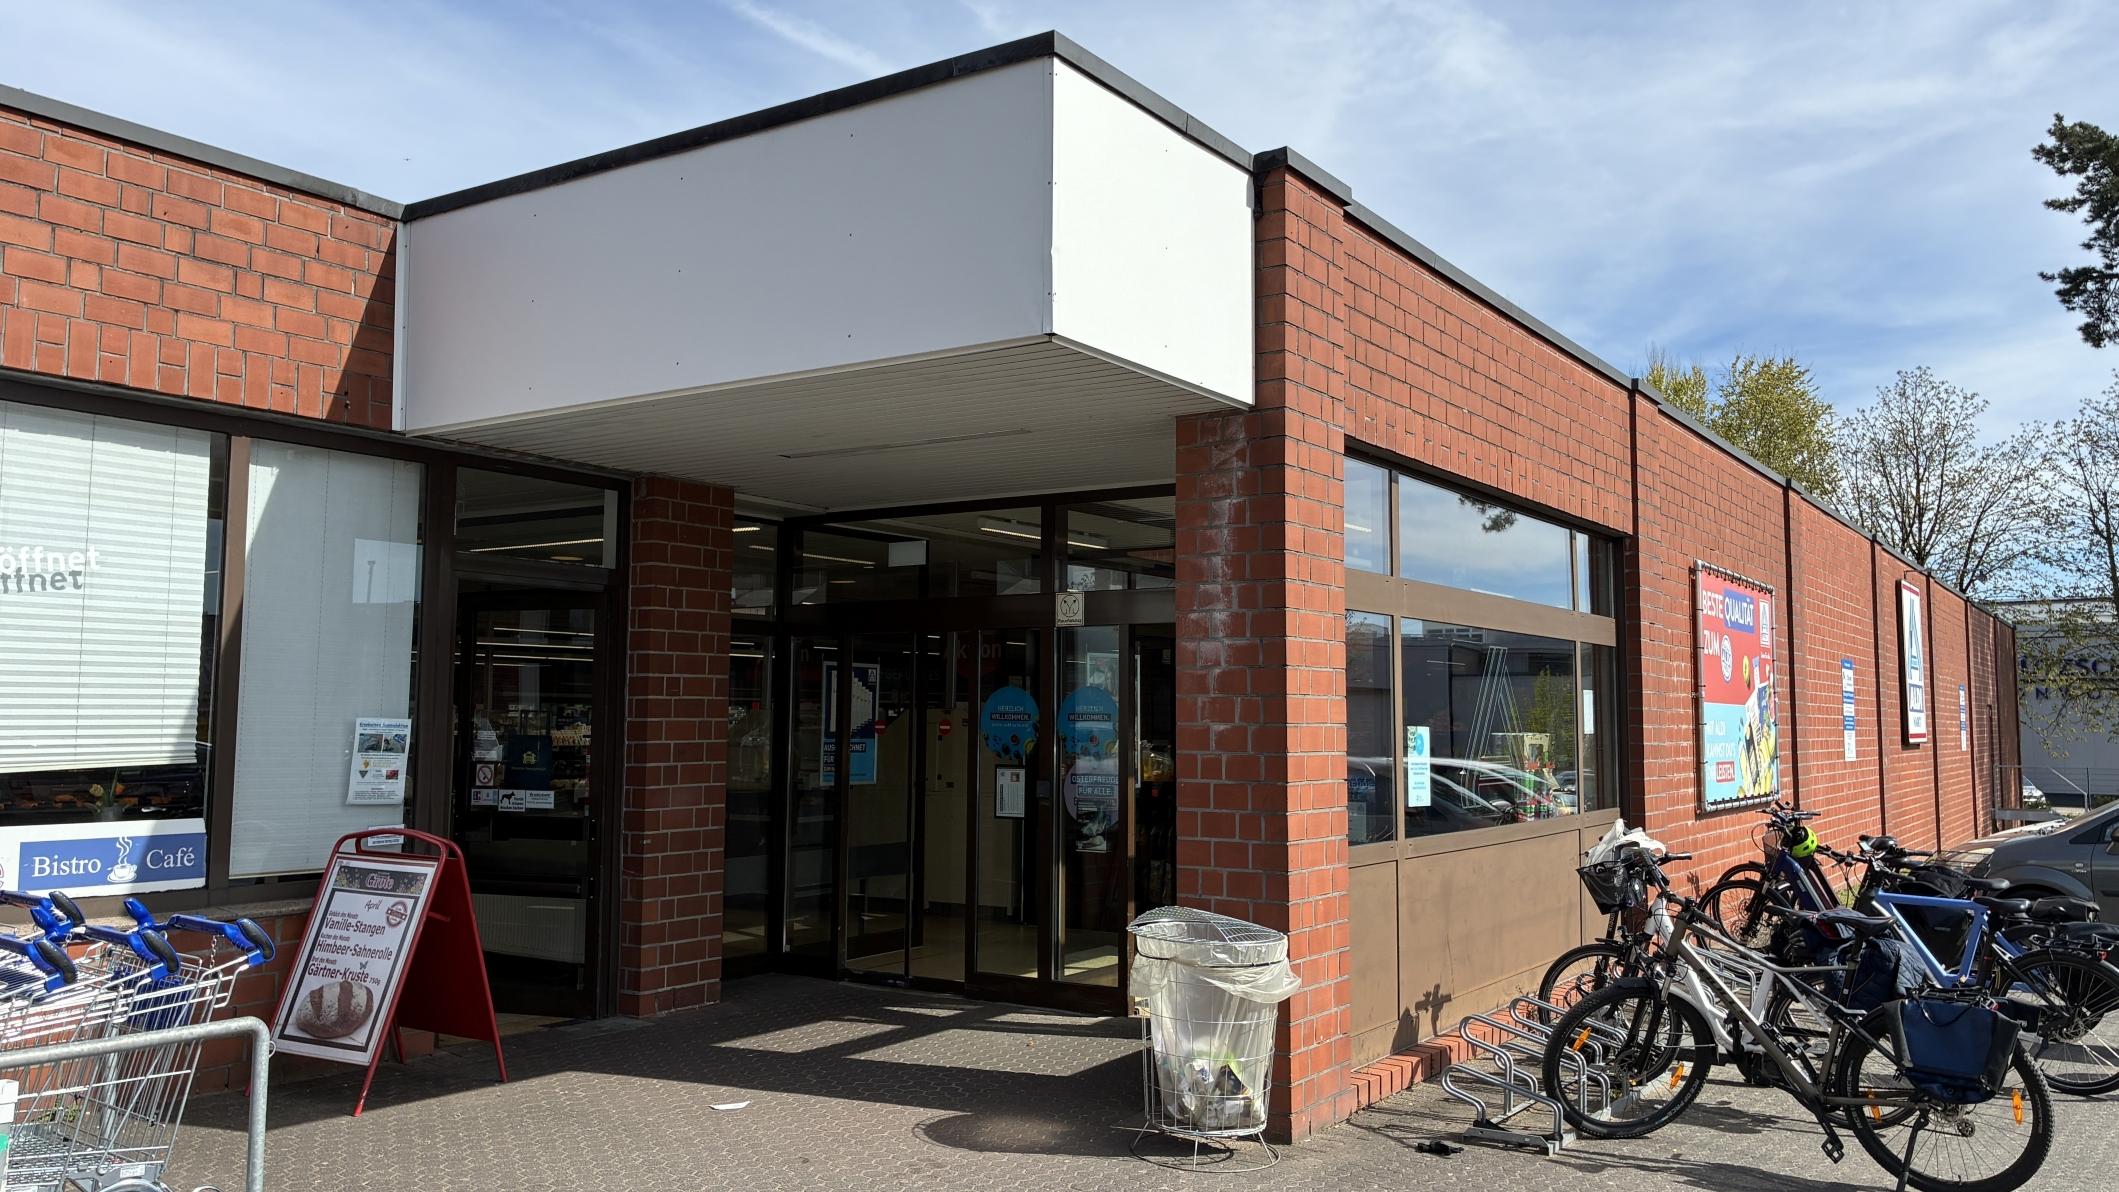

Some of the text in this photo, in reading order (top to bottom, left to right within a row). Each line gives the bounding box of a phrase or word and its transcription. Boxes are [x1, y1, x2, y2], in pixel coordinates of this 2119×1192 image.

[1702, 590, 1754, 627] BESTE QUALITÄT
[1703, 629, 1720, 656] ZUM
[31, 855, 102, 877] Bistro
[146, 847, 195, 869] Café
[364, 898, 383, 911] April
[324, 918, 386, 937] Vanille-Stangen
[315, 940, 393, 960] Himbeer-Sahnerolle
[307, 963, 381, 986] Gärtner-Kruste 750g
